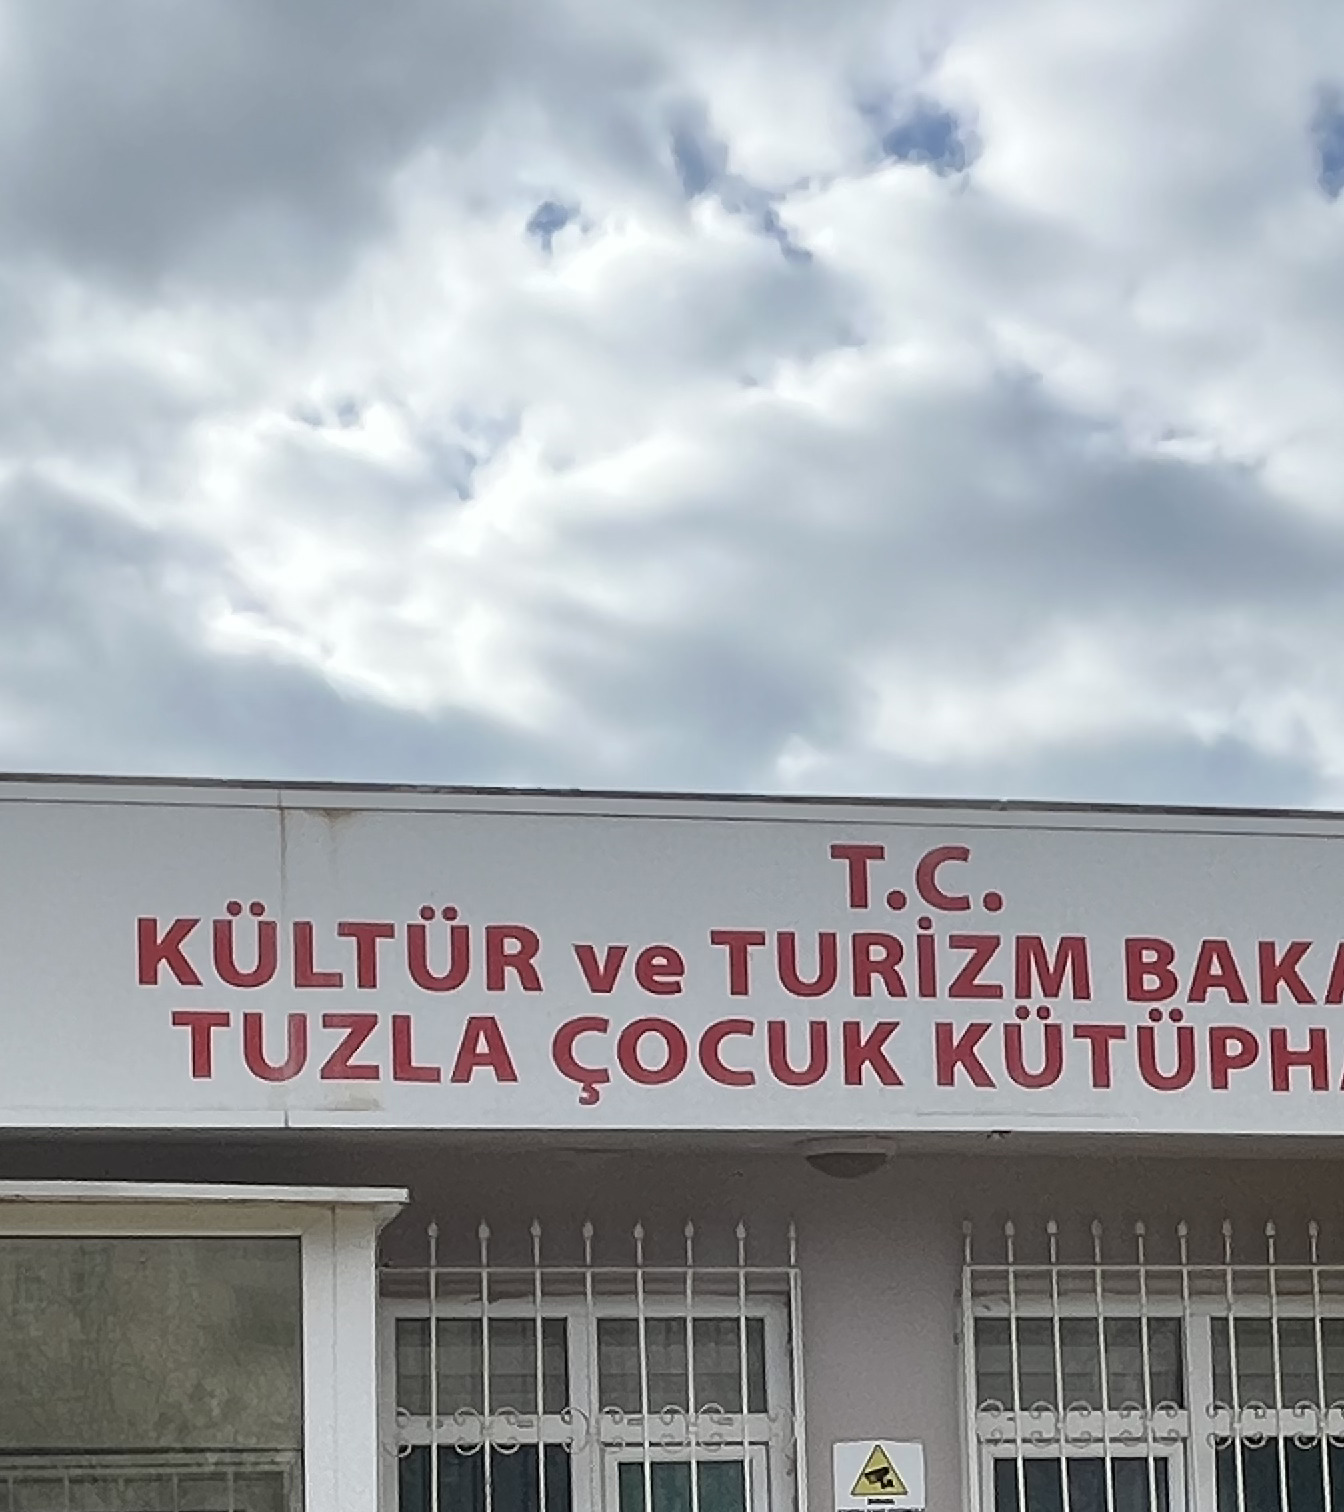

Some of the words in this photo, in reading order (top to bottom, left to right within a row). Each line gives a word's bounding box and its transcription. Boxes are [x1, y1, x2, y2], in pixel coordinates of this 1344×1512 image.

[831, 845, 1003, 912] T.C.
[138, 902, 542, 992] KÜLTÜR
[575, 945, 685, 995] ve
[711, 917, 1091, 1000] TURİZM
[172, 1011, 517, 1083] TUZLA
[553, 1016, 902, 1105] ÇOCUK
